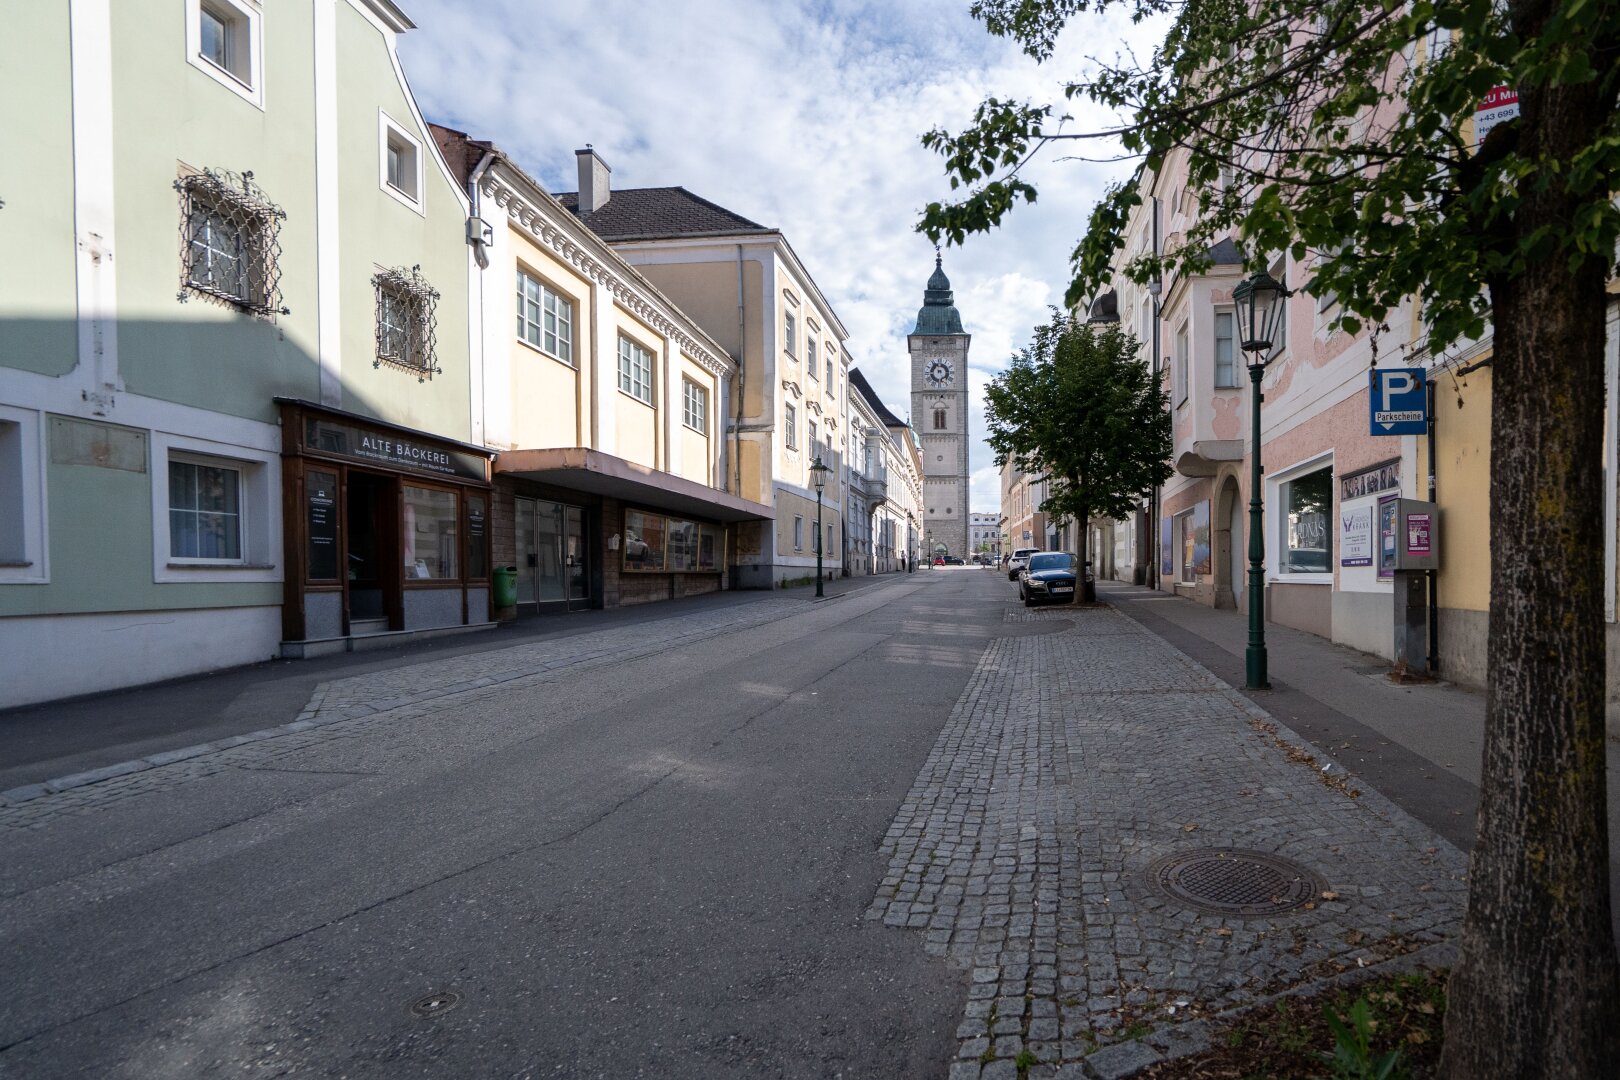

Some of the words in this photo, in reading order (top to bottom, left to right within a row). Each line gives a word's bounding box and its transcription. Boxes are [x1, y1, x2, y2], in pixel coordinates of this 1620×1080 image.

[1478, 113, 1496, 122] +43
[1497, 109, 1514, 118] 699
[1382, 372, 1415, 411] P
[1377, 412, 1422, 421] Parkscheine
[362, 437, 391, 453] ALTE
[396, 443, 449, 465] BÄCKEREI
